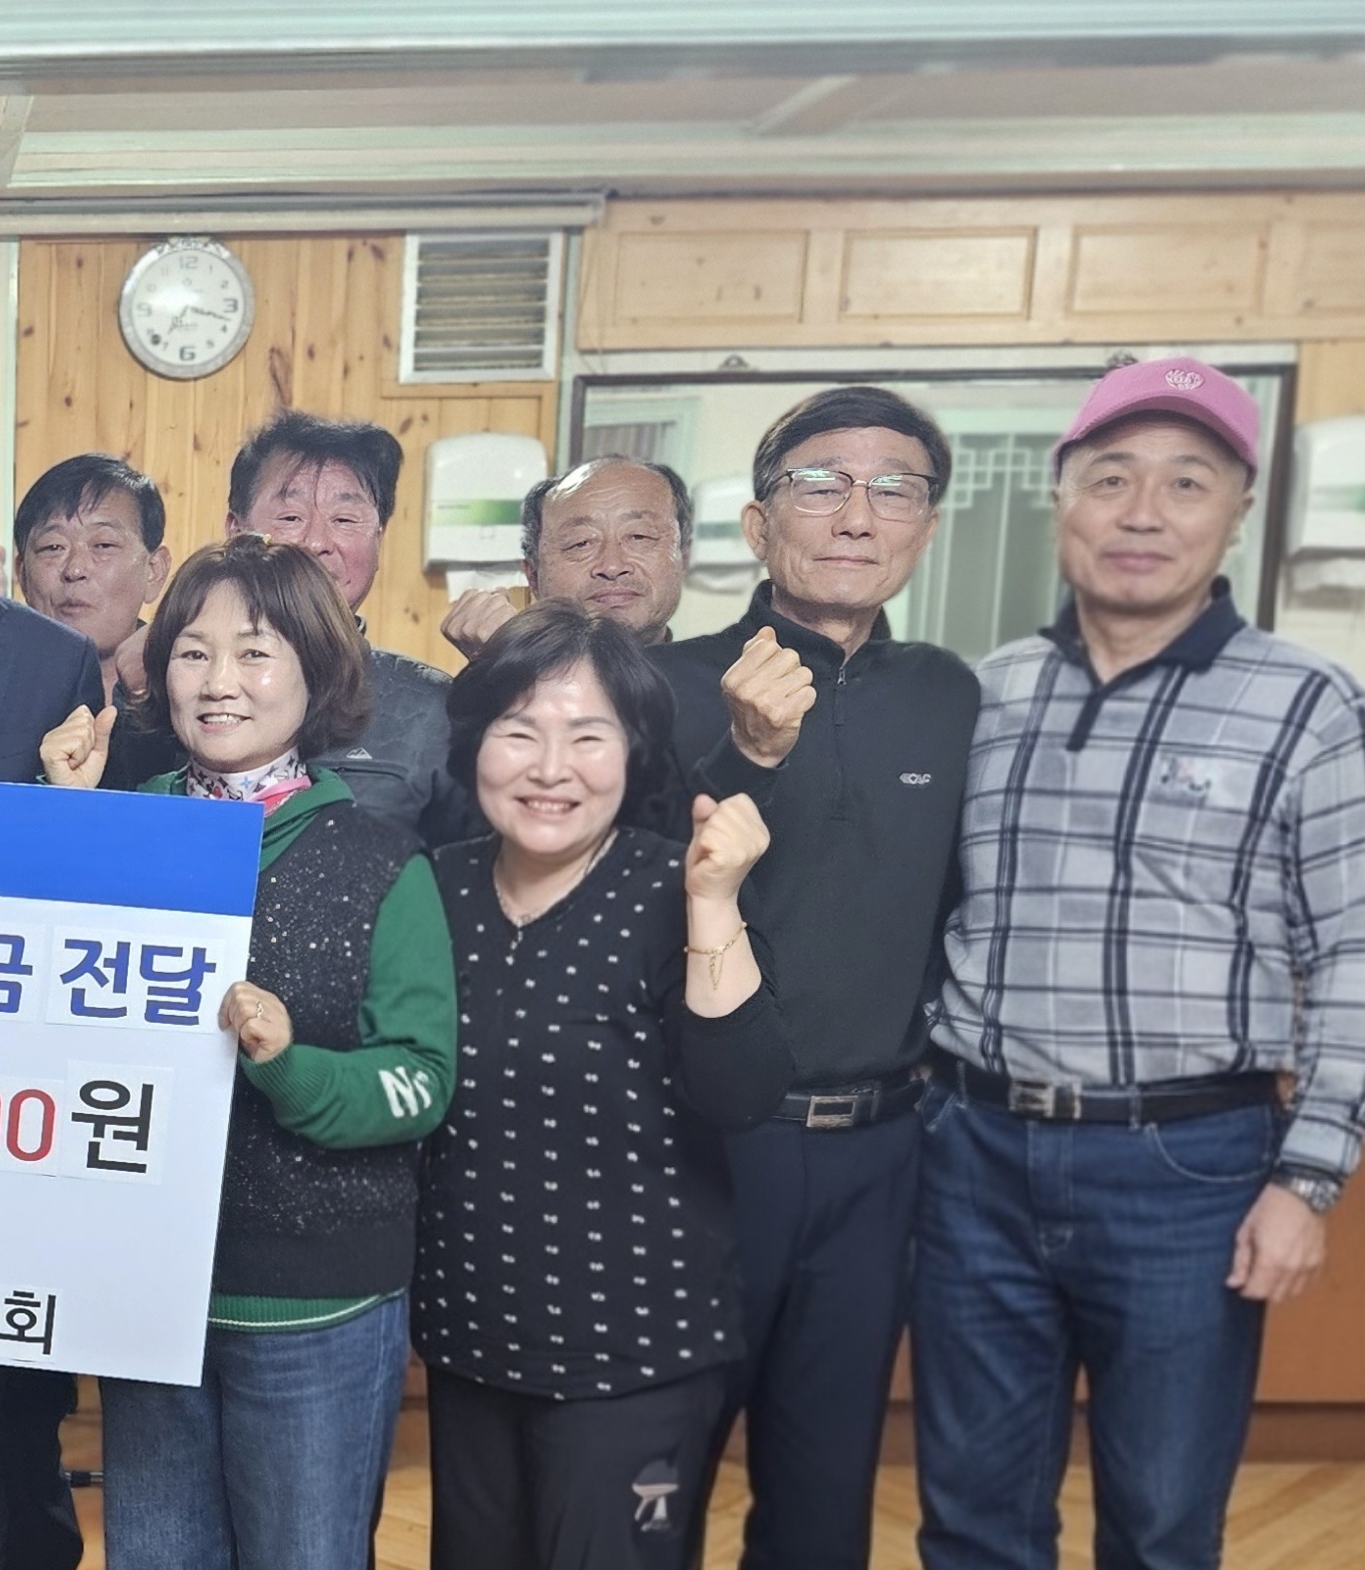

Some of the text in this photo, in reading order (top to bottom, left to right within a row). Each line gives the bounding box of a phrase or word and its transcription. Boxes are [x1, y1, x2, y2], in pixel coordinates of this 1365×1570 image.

[178, 256, 199, 270] 12
[222, 298, 238, 313] 3
[179, 346, 196, 361] 6
[59, 938, 216, 1027] 전달
